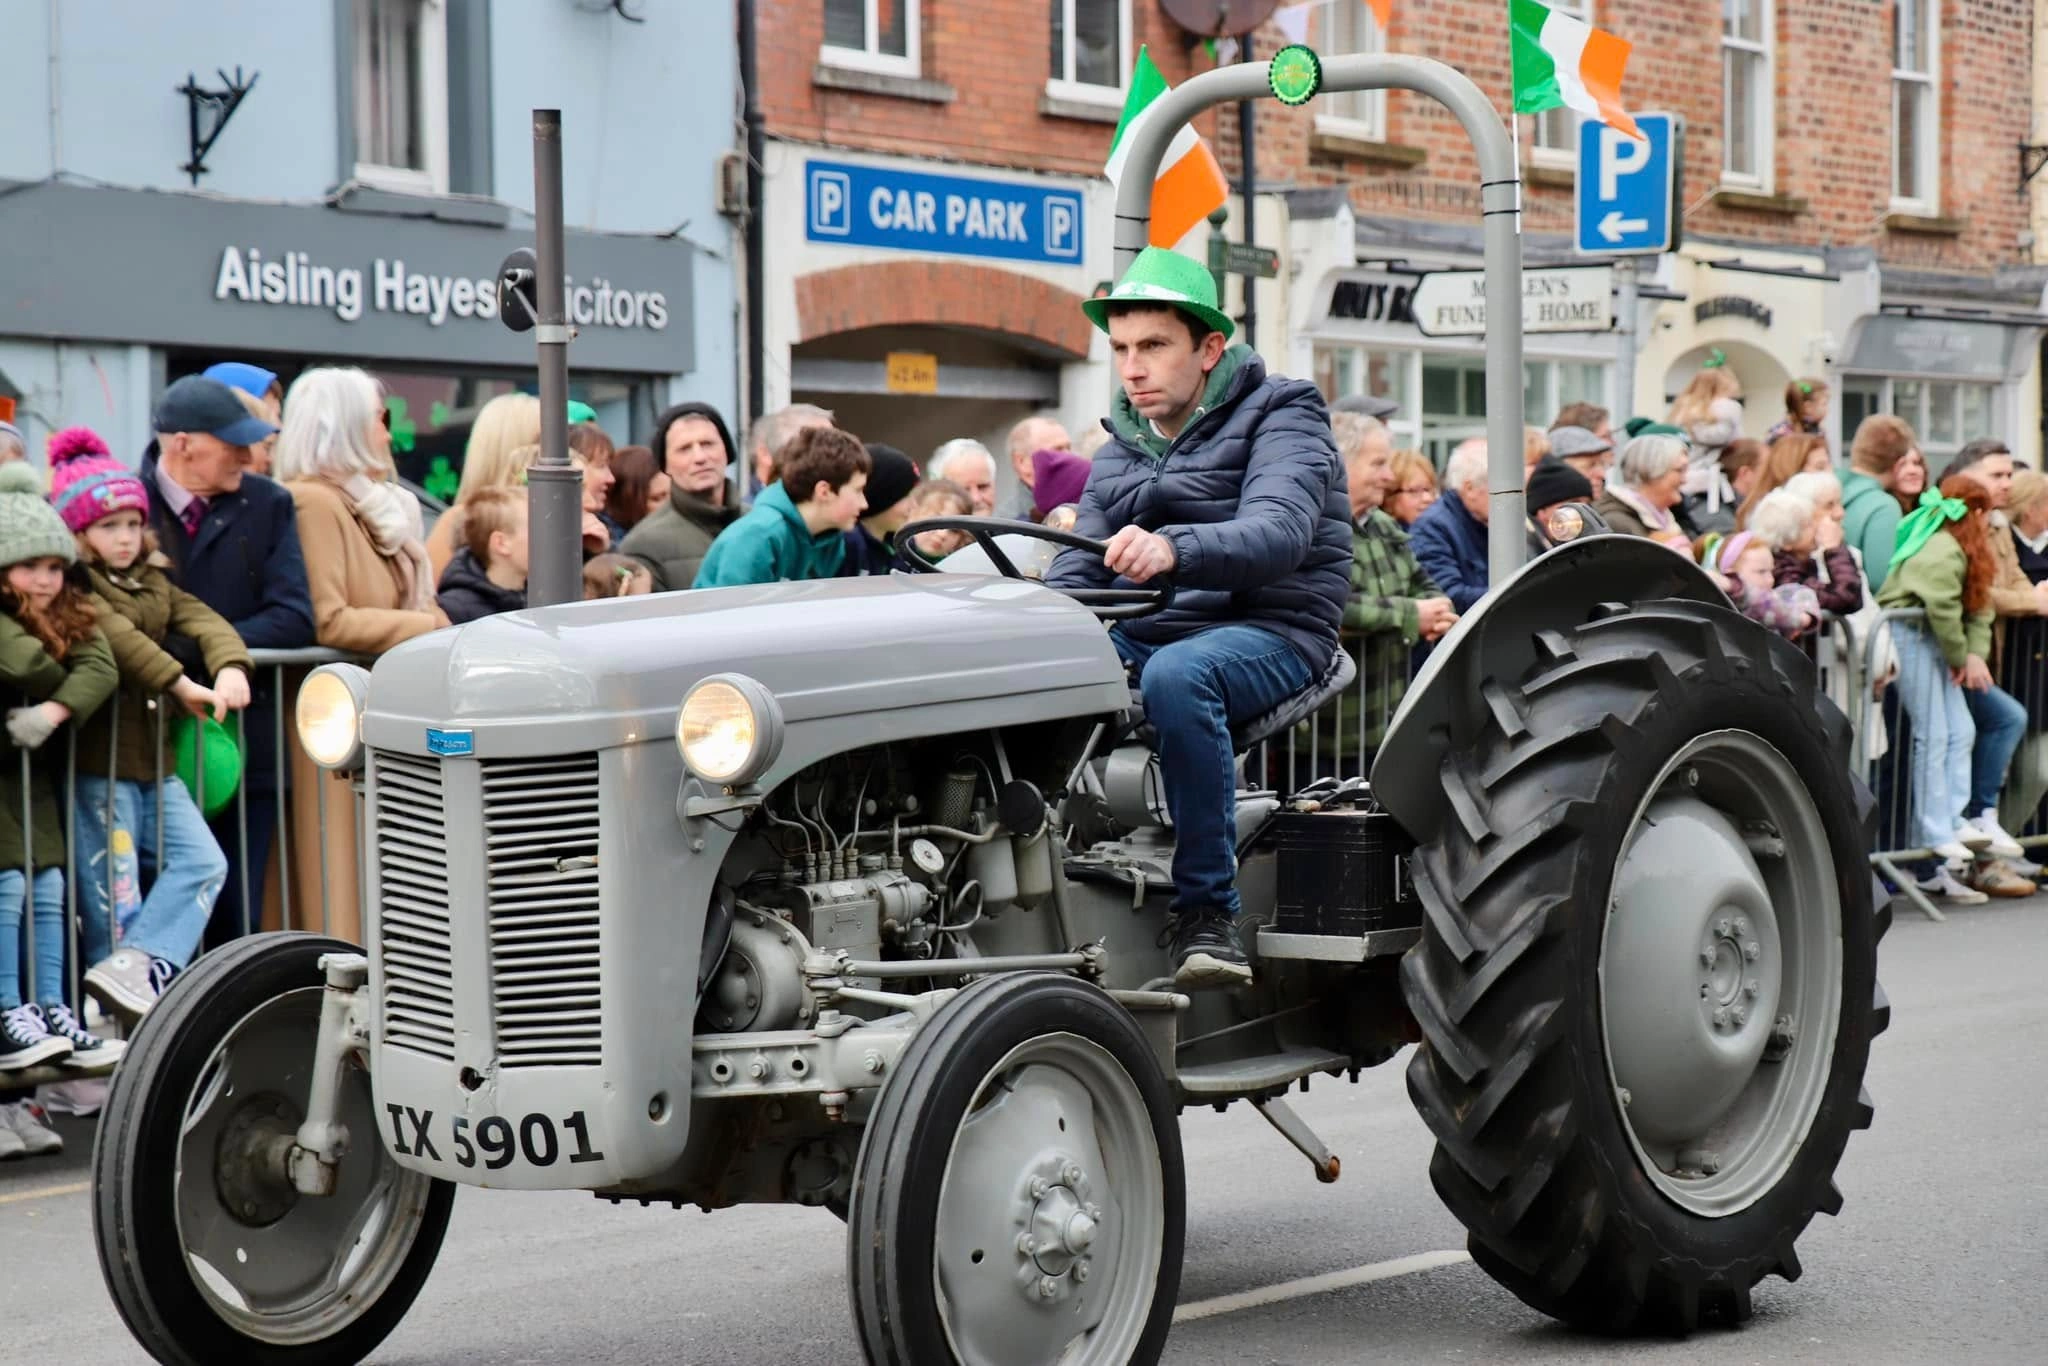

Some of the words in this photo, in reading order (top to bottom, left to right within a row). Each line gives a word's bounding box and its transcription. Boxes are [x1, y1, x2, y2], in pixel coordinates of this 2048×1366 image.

[1599, 125, 1651, 201] P
[819, 181, 842, 225] P
[869, 186, 938, 235] CAR
[946, 195, 1029, 243] PARK
[1051, 205, 1071, 249] P
[216, 246, 363, 321] Aisling
[374, 258, 498, 326] Hayes
[564, 274, 669, 329] icitors
[1539, 301, 1600, 321] HOME
[386, 1103, 443, 1162] IX
[453, 1111, 605, 1170] 5901
